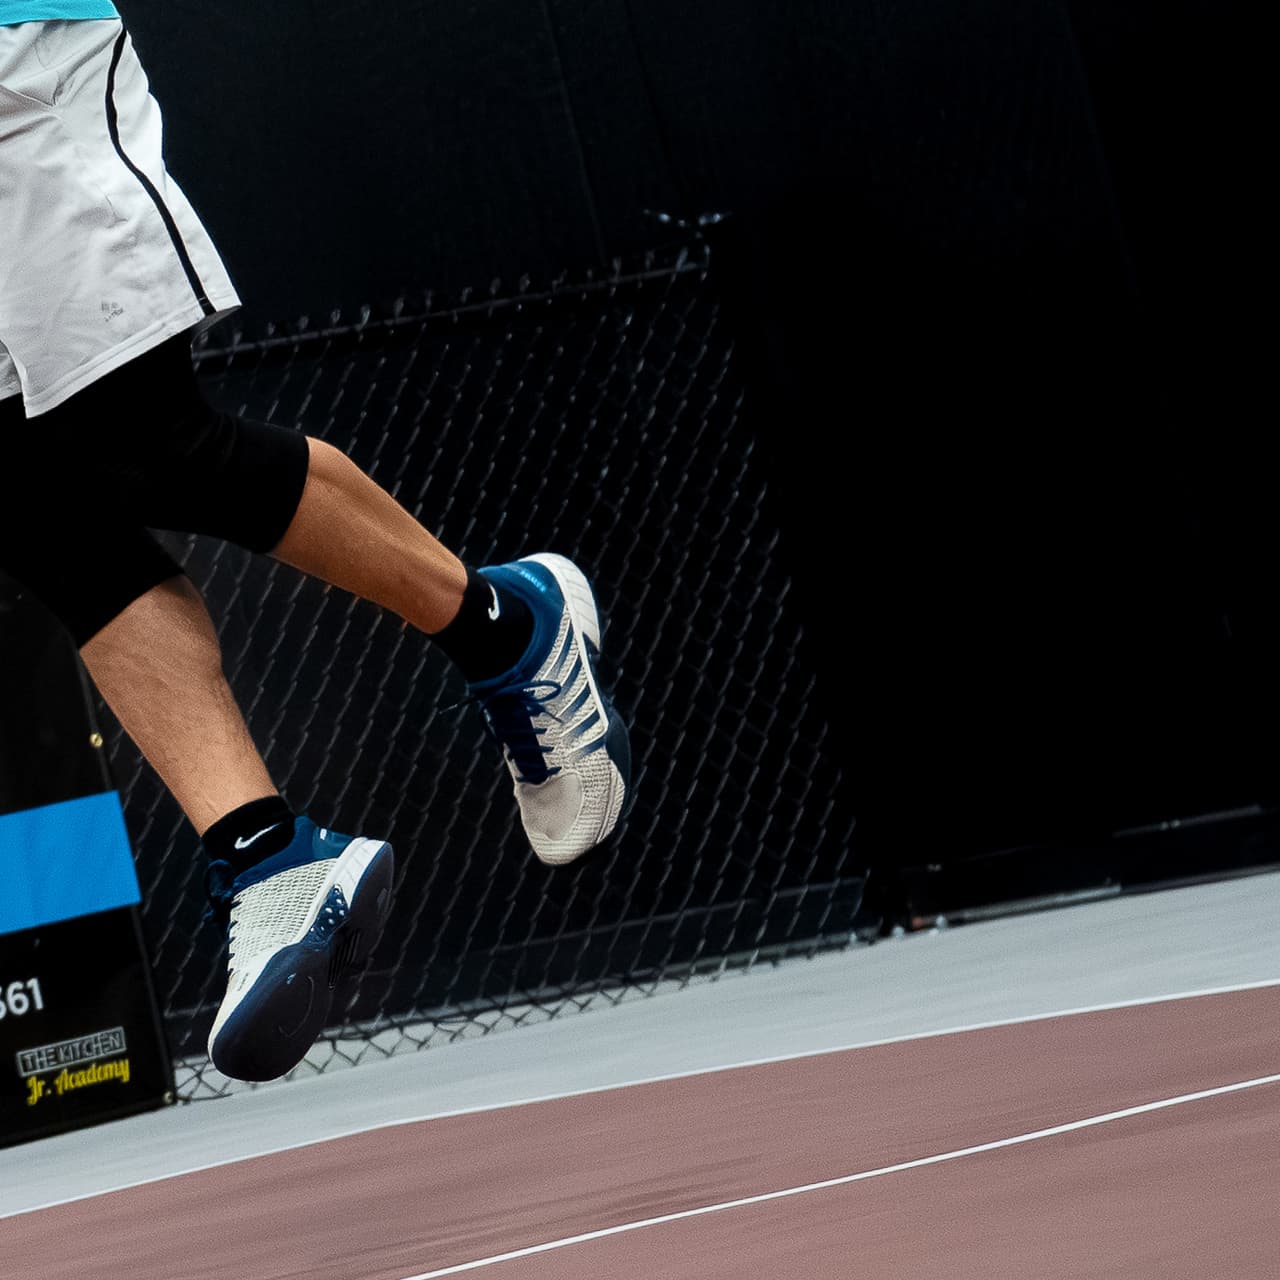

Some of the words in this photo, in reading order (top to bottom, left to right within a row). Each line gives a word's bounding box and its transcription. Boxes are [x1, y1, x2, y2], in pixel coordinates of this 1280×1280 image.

[23, 1048, 57, 1070] THE
[59, 1032, 121, 1063] KITCHEN
[27, 1075, 52, 1106] Jr.
[54, 1058, 130, 1095] Academy
